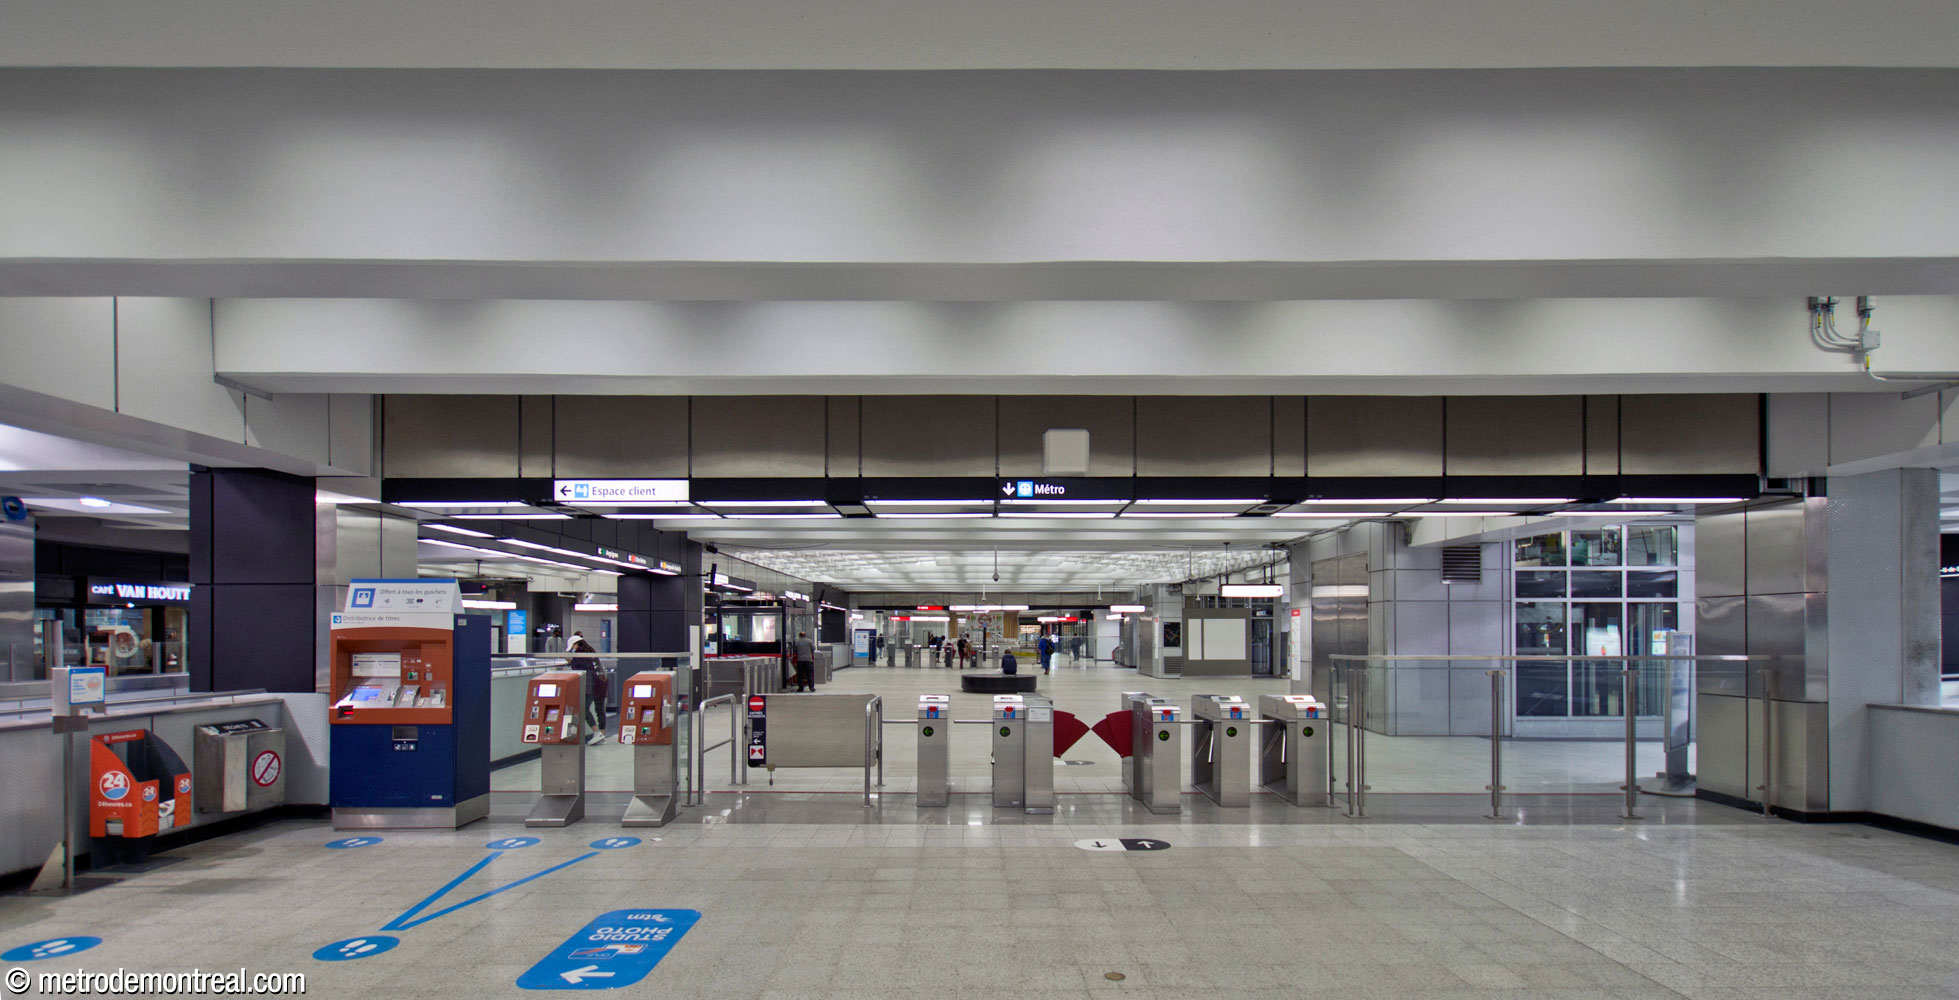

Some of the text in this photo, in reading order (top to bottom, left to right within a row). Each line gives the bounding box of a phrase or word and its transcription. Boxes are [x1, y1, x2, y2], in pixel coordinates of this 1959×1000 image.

[592, 486, 656, 498] Espace client
[1034, 484, 1065, 495] Métro
[91, 584, 114, 594] CAFÉ
[115, 584, 146, 598] VAN
[424, 588, 447, 596] guichets
[103, 773, 126, 788] 24
